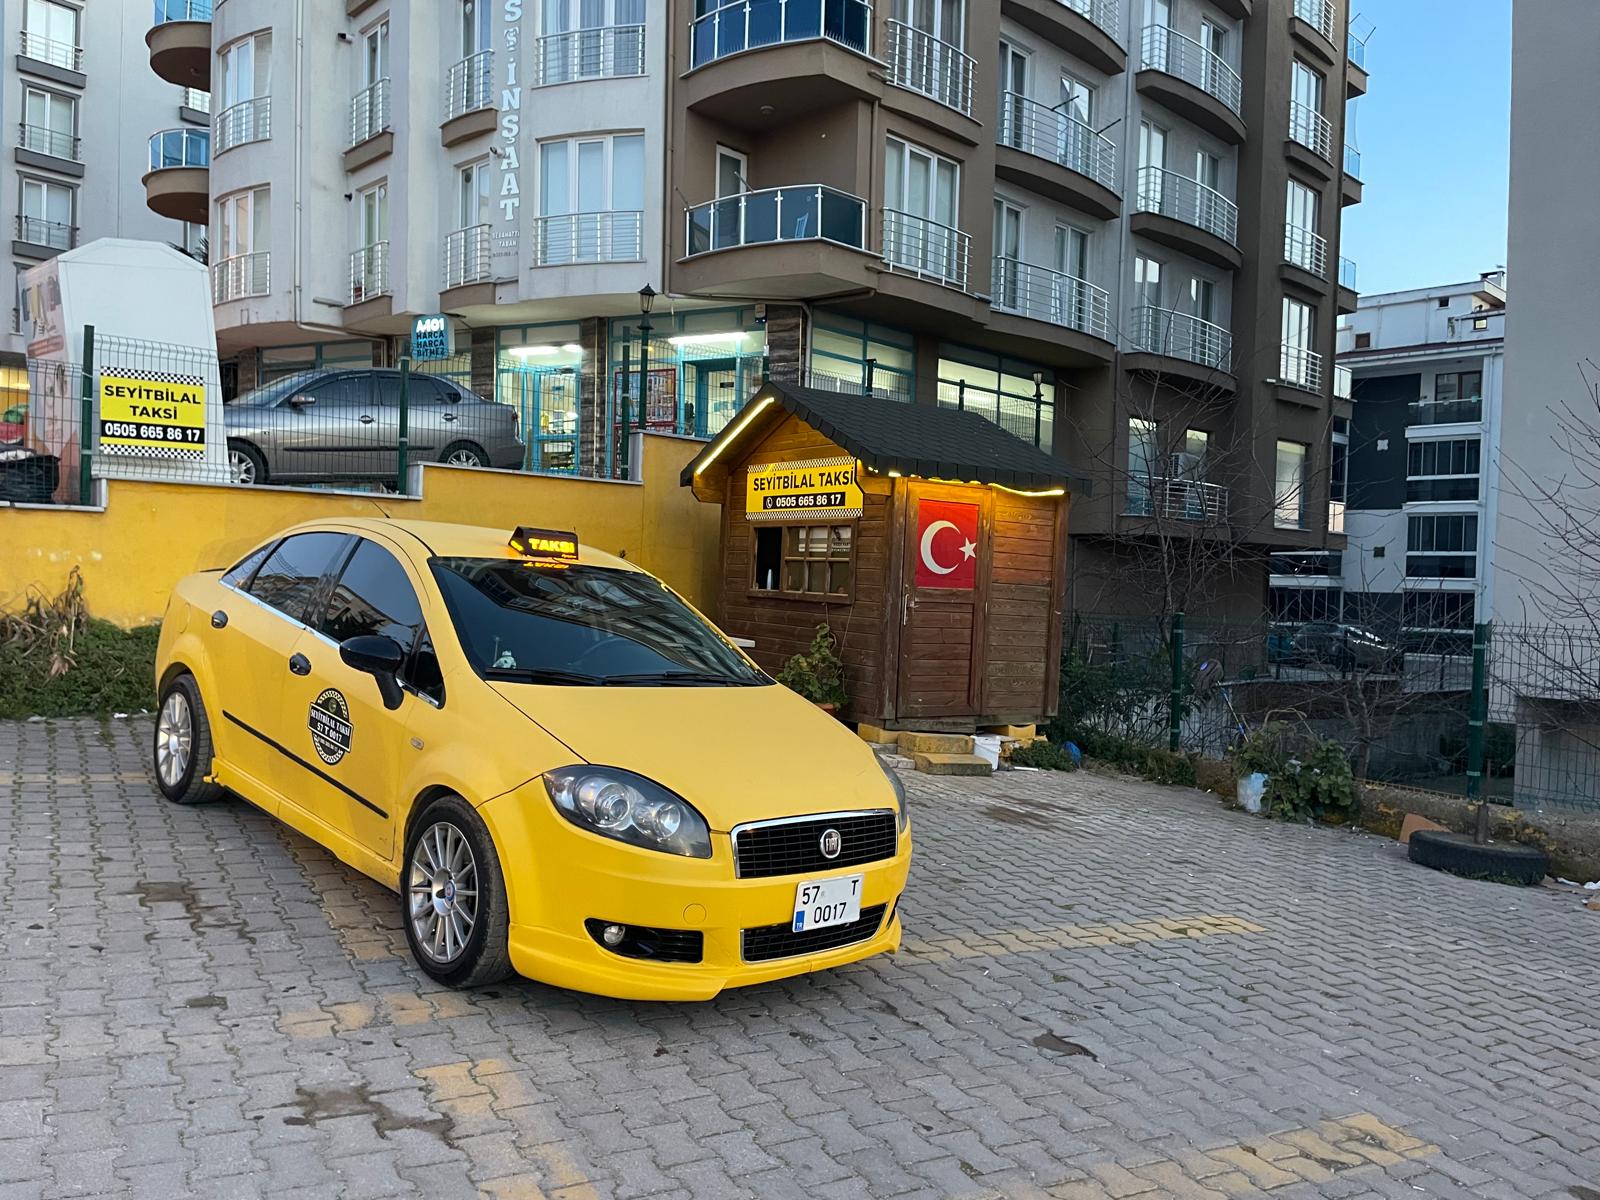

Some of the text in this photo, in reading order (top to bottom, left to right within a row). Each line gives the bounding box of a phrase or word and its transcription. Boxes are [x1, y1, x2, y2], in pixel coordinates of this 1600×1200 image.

[416, 318, 445, 332] A101
[416, 331, 445, 339] HARCA
[416, 339, 445, 348] HARCA
[104, 385, 201, 405] SEYİTBİLAL
[129, 405, 178, 420] TAKSİ
[105, 422, 200, 441] 0505 665 86 17
[753, 467, 854, 491] SEYİTBİLAL TAKSİ
[776, 494, 842, 507] 0505 665 86 17
[317, 722, 343, 742] 57 T 0017
[825, 837, 838, 852] FIAT
[802, 879, 860, 905] 57 T
[813, 902, 847, 924] 0017
